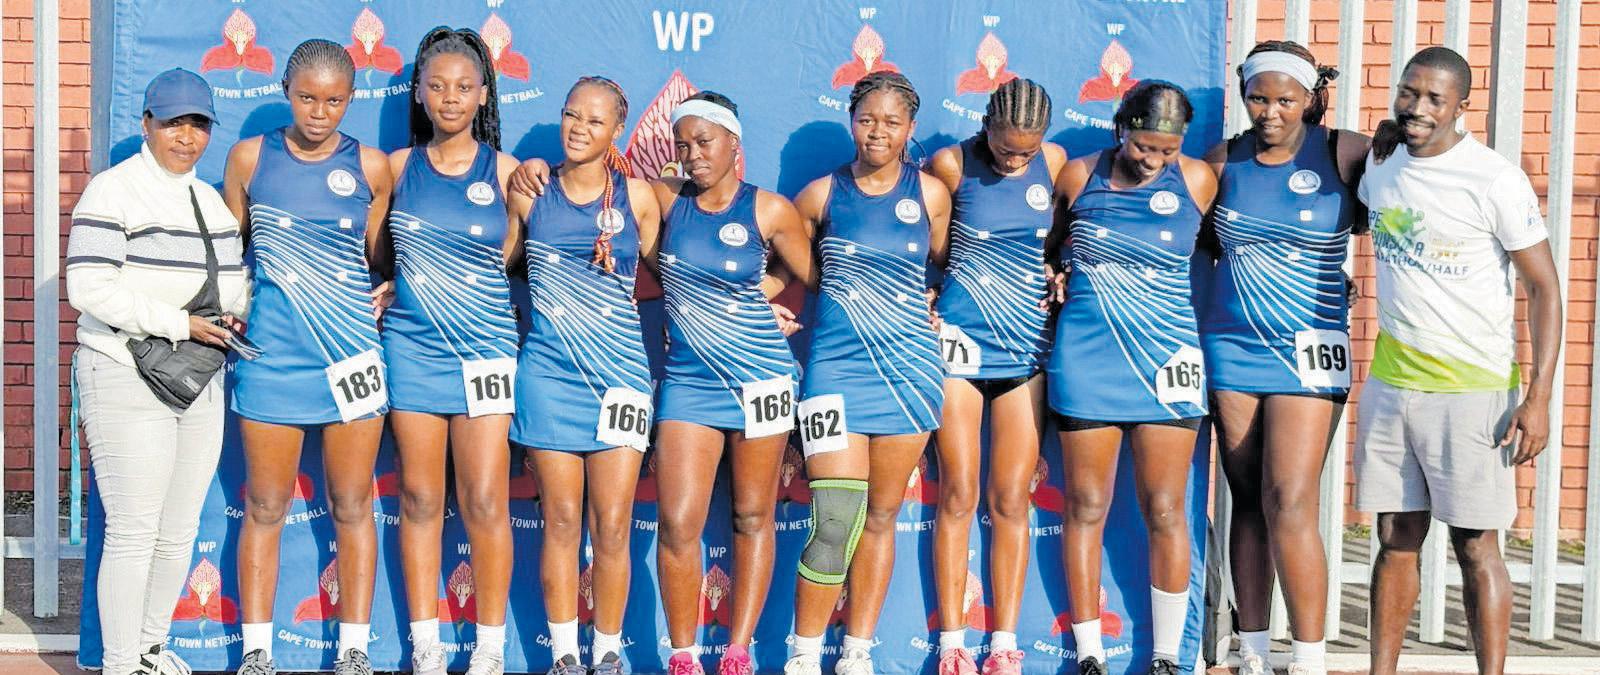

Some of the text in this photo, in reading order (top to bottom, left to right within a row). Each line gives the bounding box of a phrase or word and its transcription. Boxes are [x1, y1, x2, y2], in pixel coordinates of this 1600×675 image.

[859, 8, 877, 20] WP
[983, 16, 1001, 27] WP
[652, 10, 715, 52] WP
[1106, 23, 1125, 35] WP
[213, 86, 241, 99] TOWN
[500, 88, 544, 104] NETBALL
[818, 95, 842, 112] CAPE
[943, 99, 966, 117] CAPE
[1064, 108, 1089, 126] CAPE
[1302, 344, 1347, 372] 169
[336, 365, 381, 403] 183
[1164, 361, 1200, 390] 165
[470, 373, 512, 401] 161
[750, 390, 790, 423] 168
[607, 402, 647, 436] 166
[803, 409, 841, 442] 162
[511, 517, 538, 529] TOWN
[198, 541, 217, 553] WP
[709, 547, 727, 558] WP
[174, 637, 201, 649] TOWN
[278, 629, 303, 646] CAPE
[304, 638, 333, 649] TOWN
[910, 637, 934, 653] CAPE
[1033, 640, 1058, 656] CAPE
